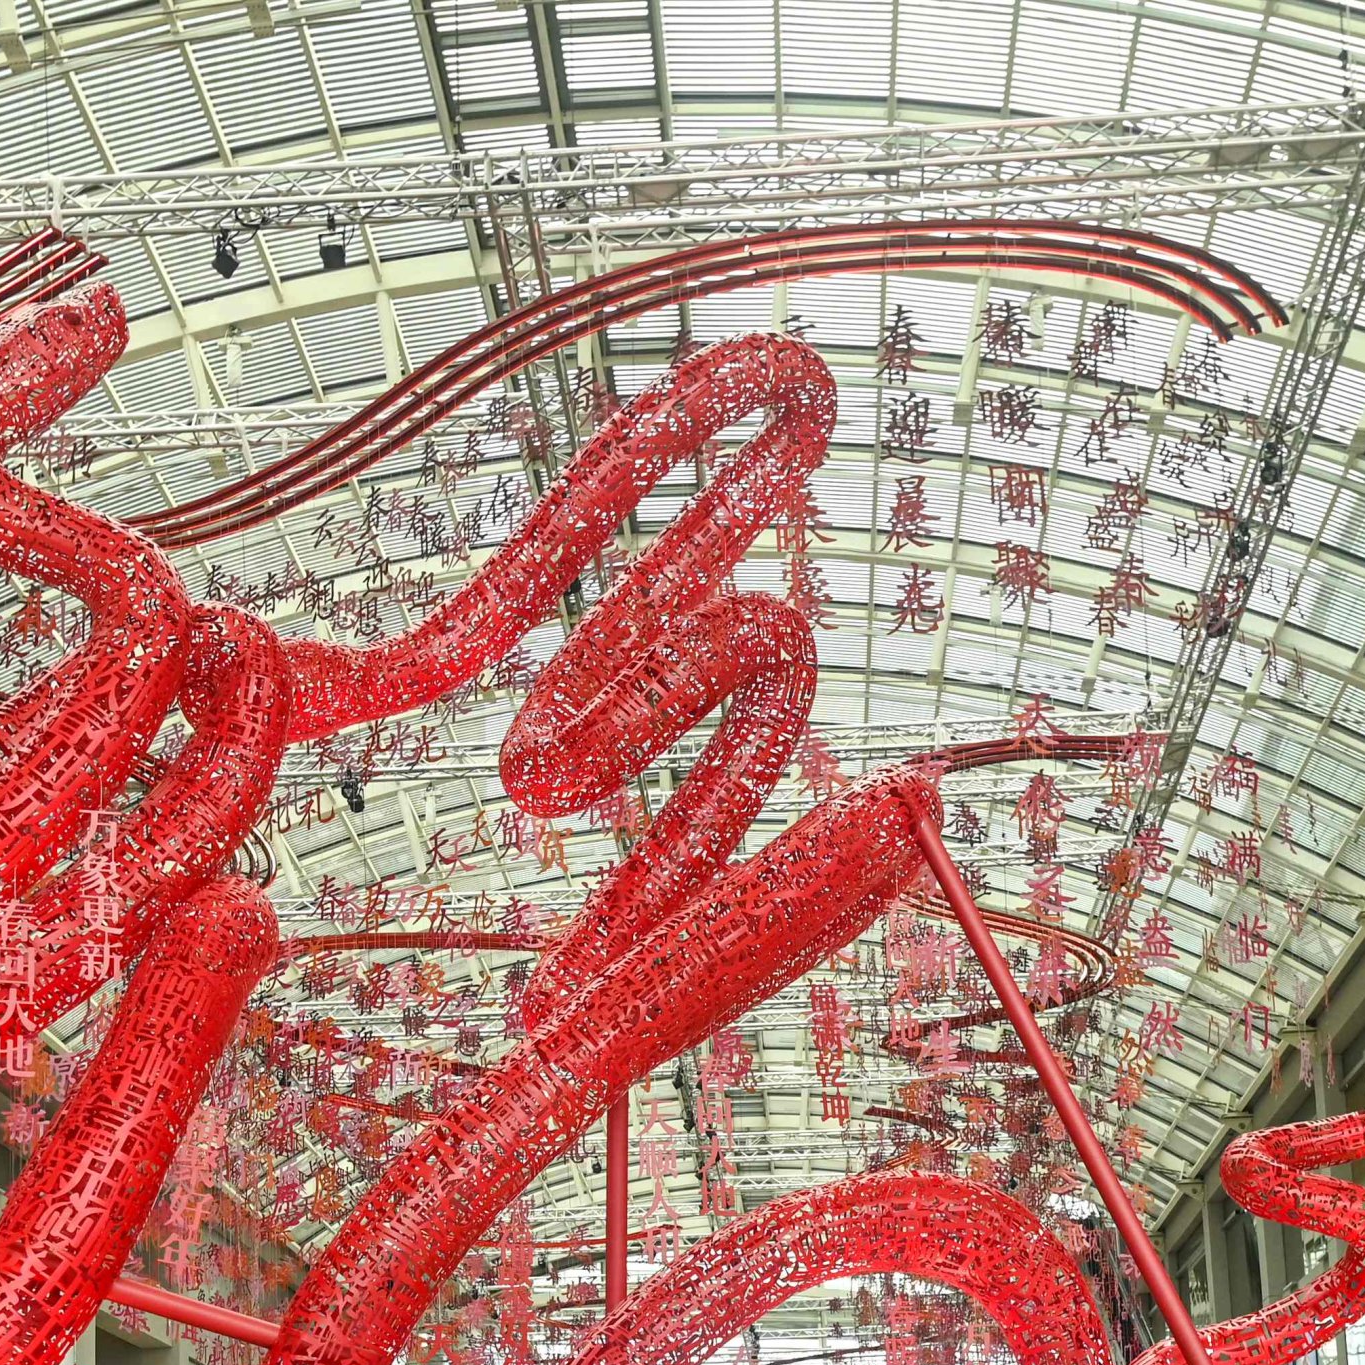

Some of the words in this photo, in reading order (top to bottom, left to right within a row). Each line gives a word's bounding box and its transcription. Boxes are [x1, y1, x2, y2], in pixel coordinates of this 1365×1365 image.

[79, 808, 122, 982] 万象更新
[636, 1100, 681, 1265] 天顺人和
